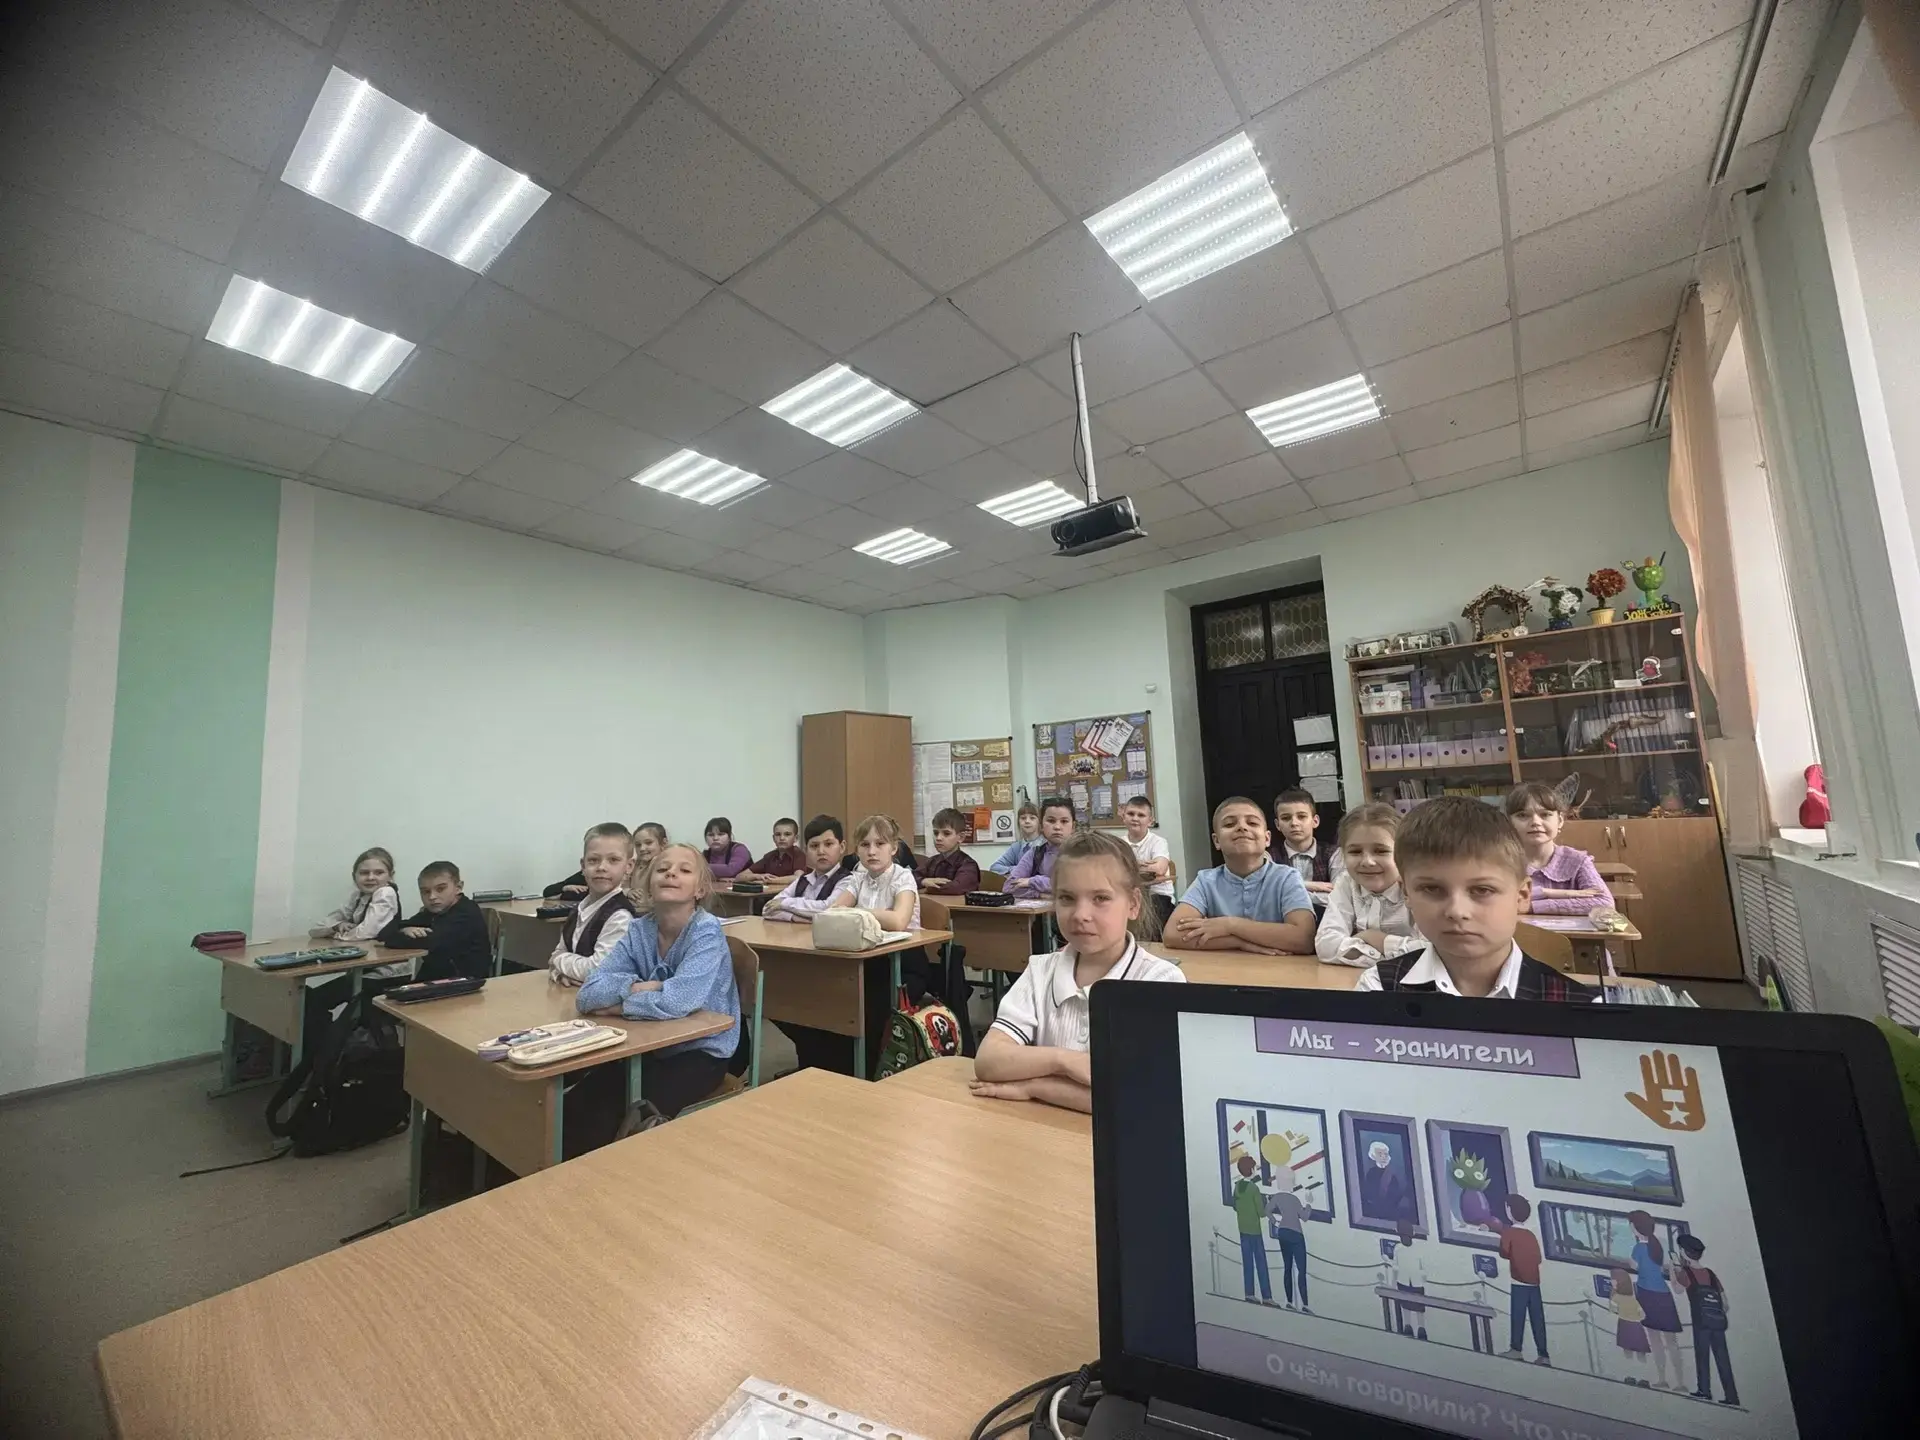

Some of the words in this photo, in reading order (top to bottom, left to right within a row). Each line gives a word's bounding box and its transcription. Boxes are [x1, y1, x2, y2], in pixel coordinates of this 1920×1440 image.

[1623, 608, 1647, 621] ЗОЖ
[1289, 1026, 1334, 1051] Мы
[1374, 1036, 1535, 1066] хранители
[1266, 1353, 1284, 1375] О
[1289, 1361, 1339, 1390] чём
[1500, 1408, 1554, 1440] Что
